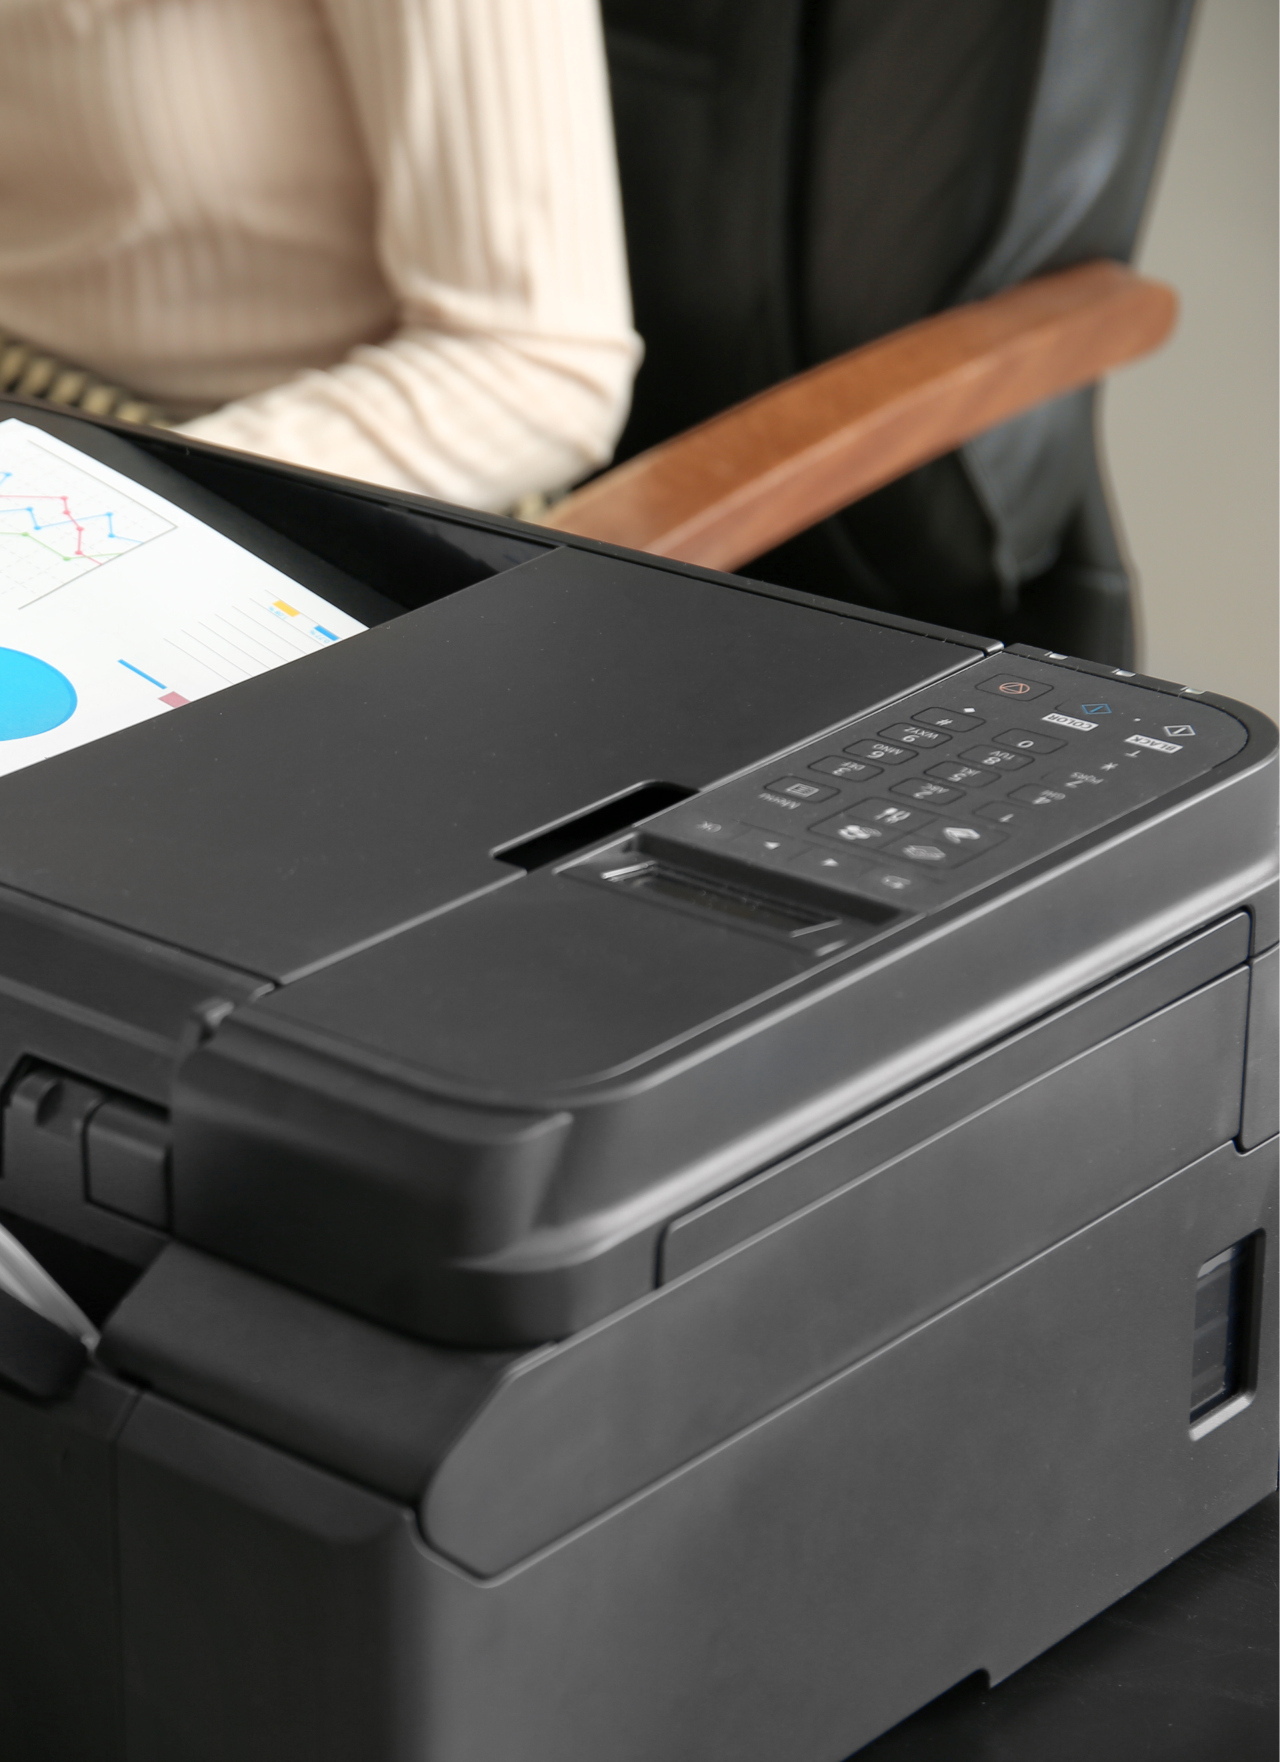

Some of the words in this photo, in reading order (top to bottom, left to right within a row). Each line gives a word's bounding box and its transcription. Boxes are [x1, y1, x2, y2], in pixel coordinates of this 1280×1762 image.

[1047, 714, 1093, 729] COLOR
[904, 726, 939, 739] WXYZ
[902, 734, 920, 743] 9
[1133, 736, 1176, 750] BLACK
[872, 743, 904, 755] MNO
[1017, 740, 1034, 748] 0
[866, 750, 885, 759] 6
[989, 750, 1015, 760] TUV
[982, 756, 1001, 765] 8
[840, 761, 866, 771] DEF
[960, 766, 981, 776] JKL
[832, 767, 851, 776] 3
[947, 772, 967, 782] 5
[1070, 771, 1104, 785] PQRS
[921, 783, 950, 794] ABC
[1064, 780, 1084, 788] 7
[913, 790, 933, 799] 2
[759, 793, 801, 809] Menu
